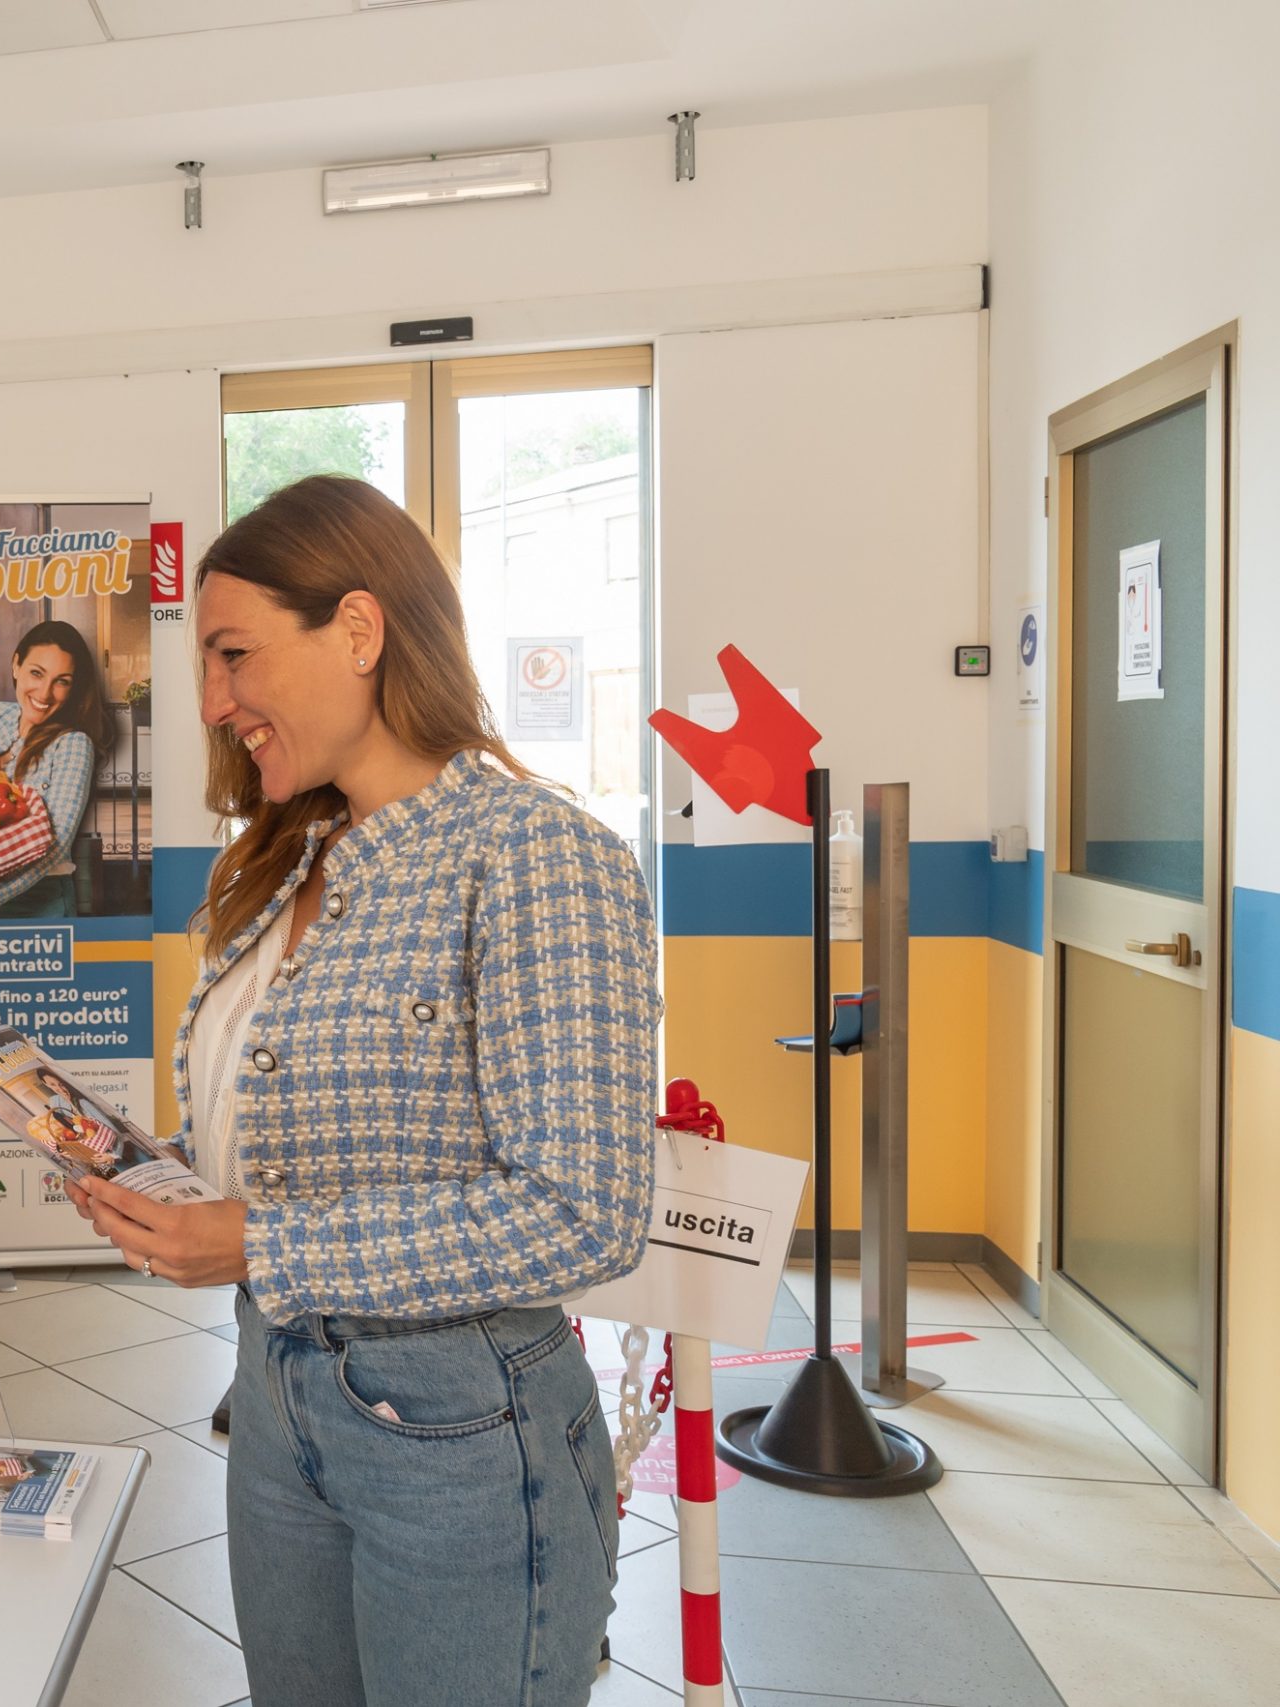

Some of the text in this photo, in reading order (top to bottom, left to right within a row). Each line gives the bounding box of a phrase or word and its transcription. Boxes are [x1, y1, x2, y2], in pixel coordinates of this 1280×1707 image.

[0, 990, 32, 1003] fino
[35, 993, 45, 1002] a
[49, 989, 78, 1002] 120
[7, 1008, 28, 1026] in
[35, 1006, 129, 1030] prodotti
[48, 1031, 128, 1046] territorio
[664, 1209, 755, 1244] uscita
